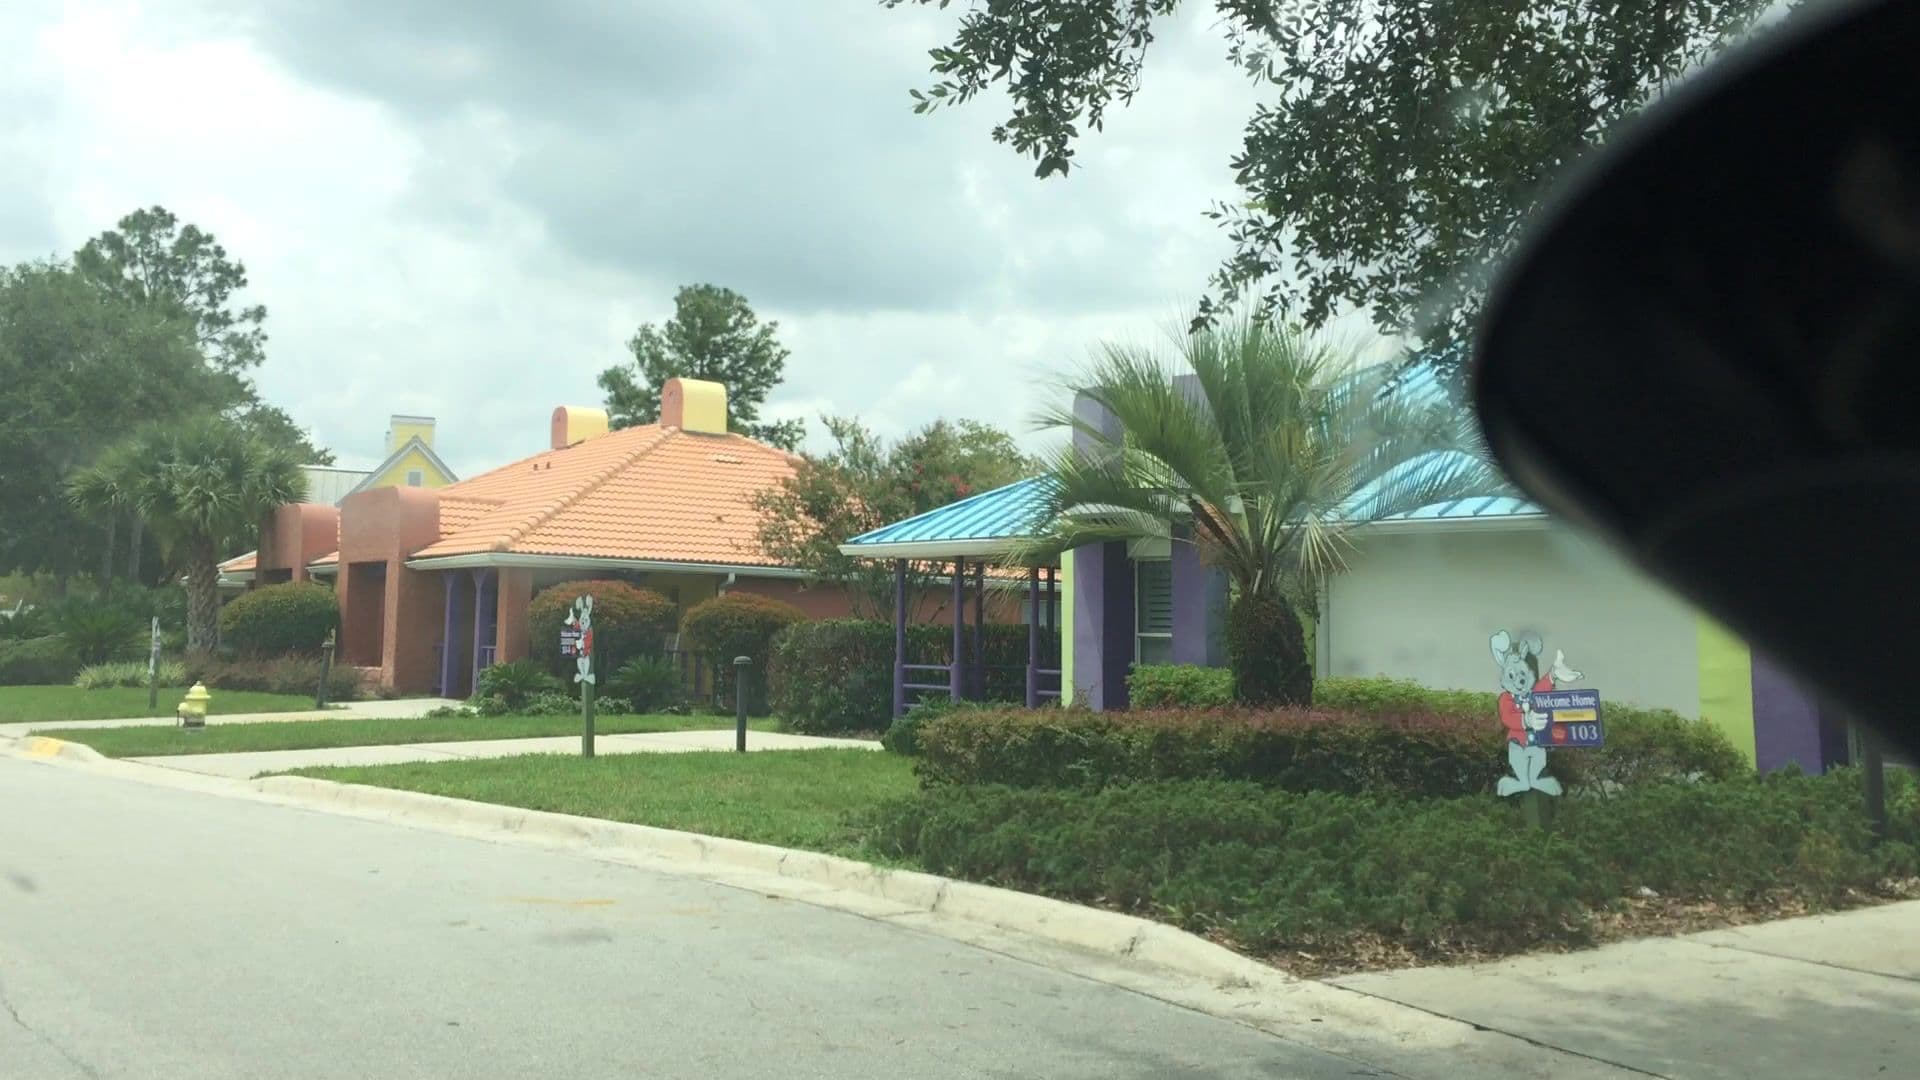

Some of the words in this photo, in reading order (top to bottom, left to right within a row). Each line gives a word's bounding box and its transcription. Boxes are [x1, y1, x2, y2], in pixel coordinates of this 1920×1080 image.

[1534, 695, 1570, 708] Welcome
[1571, 694, 1595, 706] Home
[1571, 725, 1598, 740] 103
